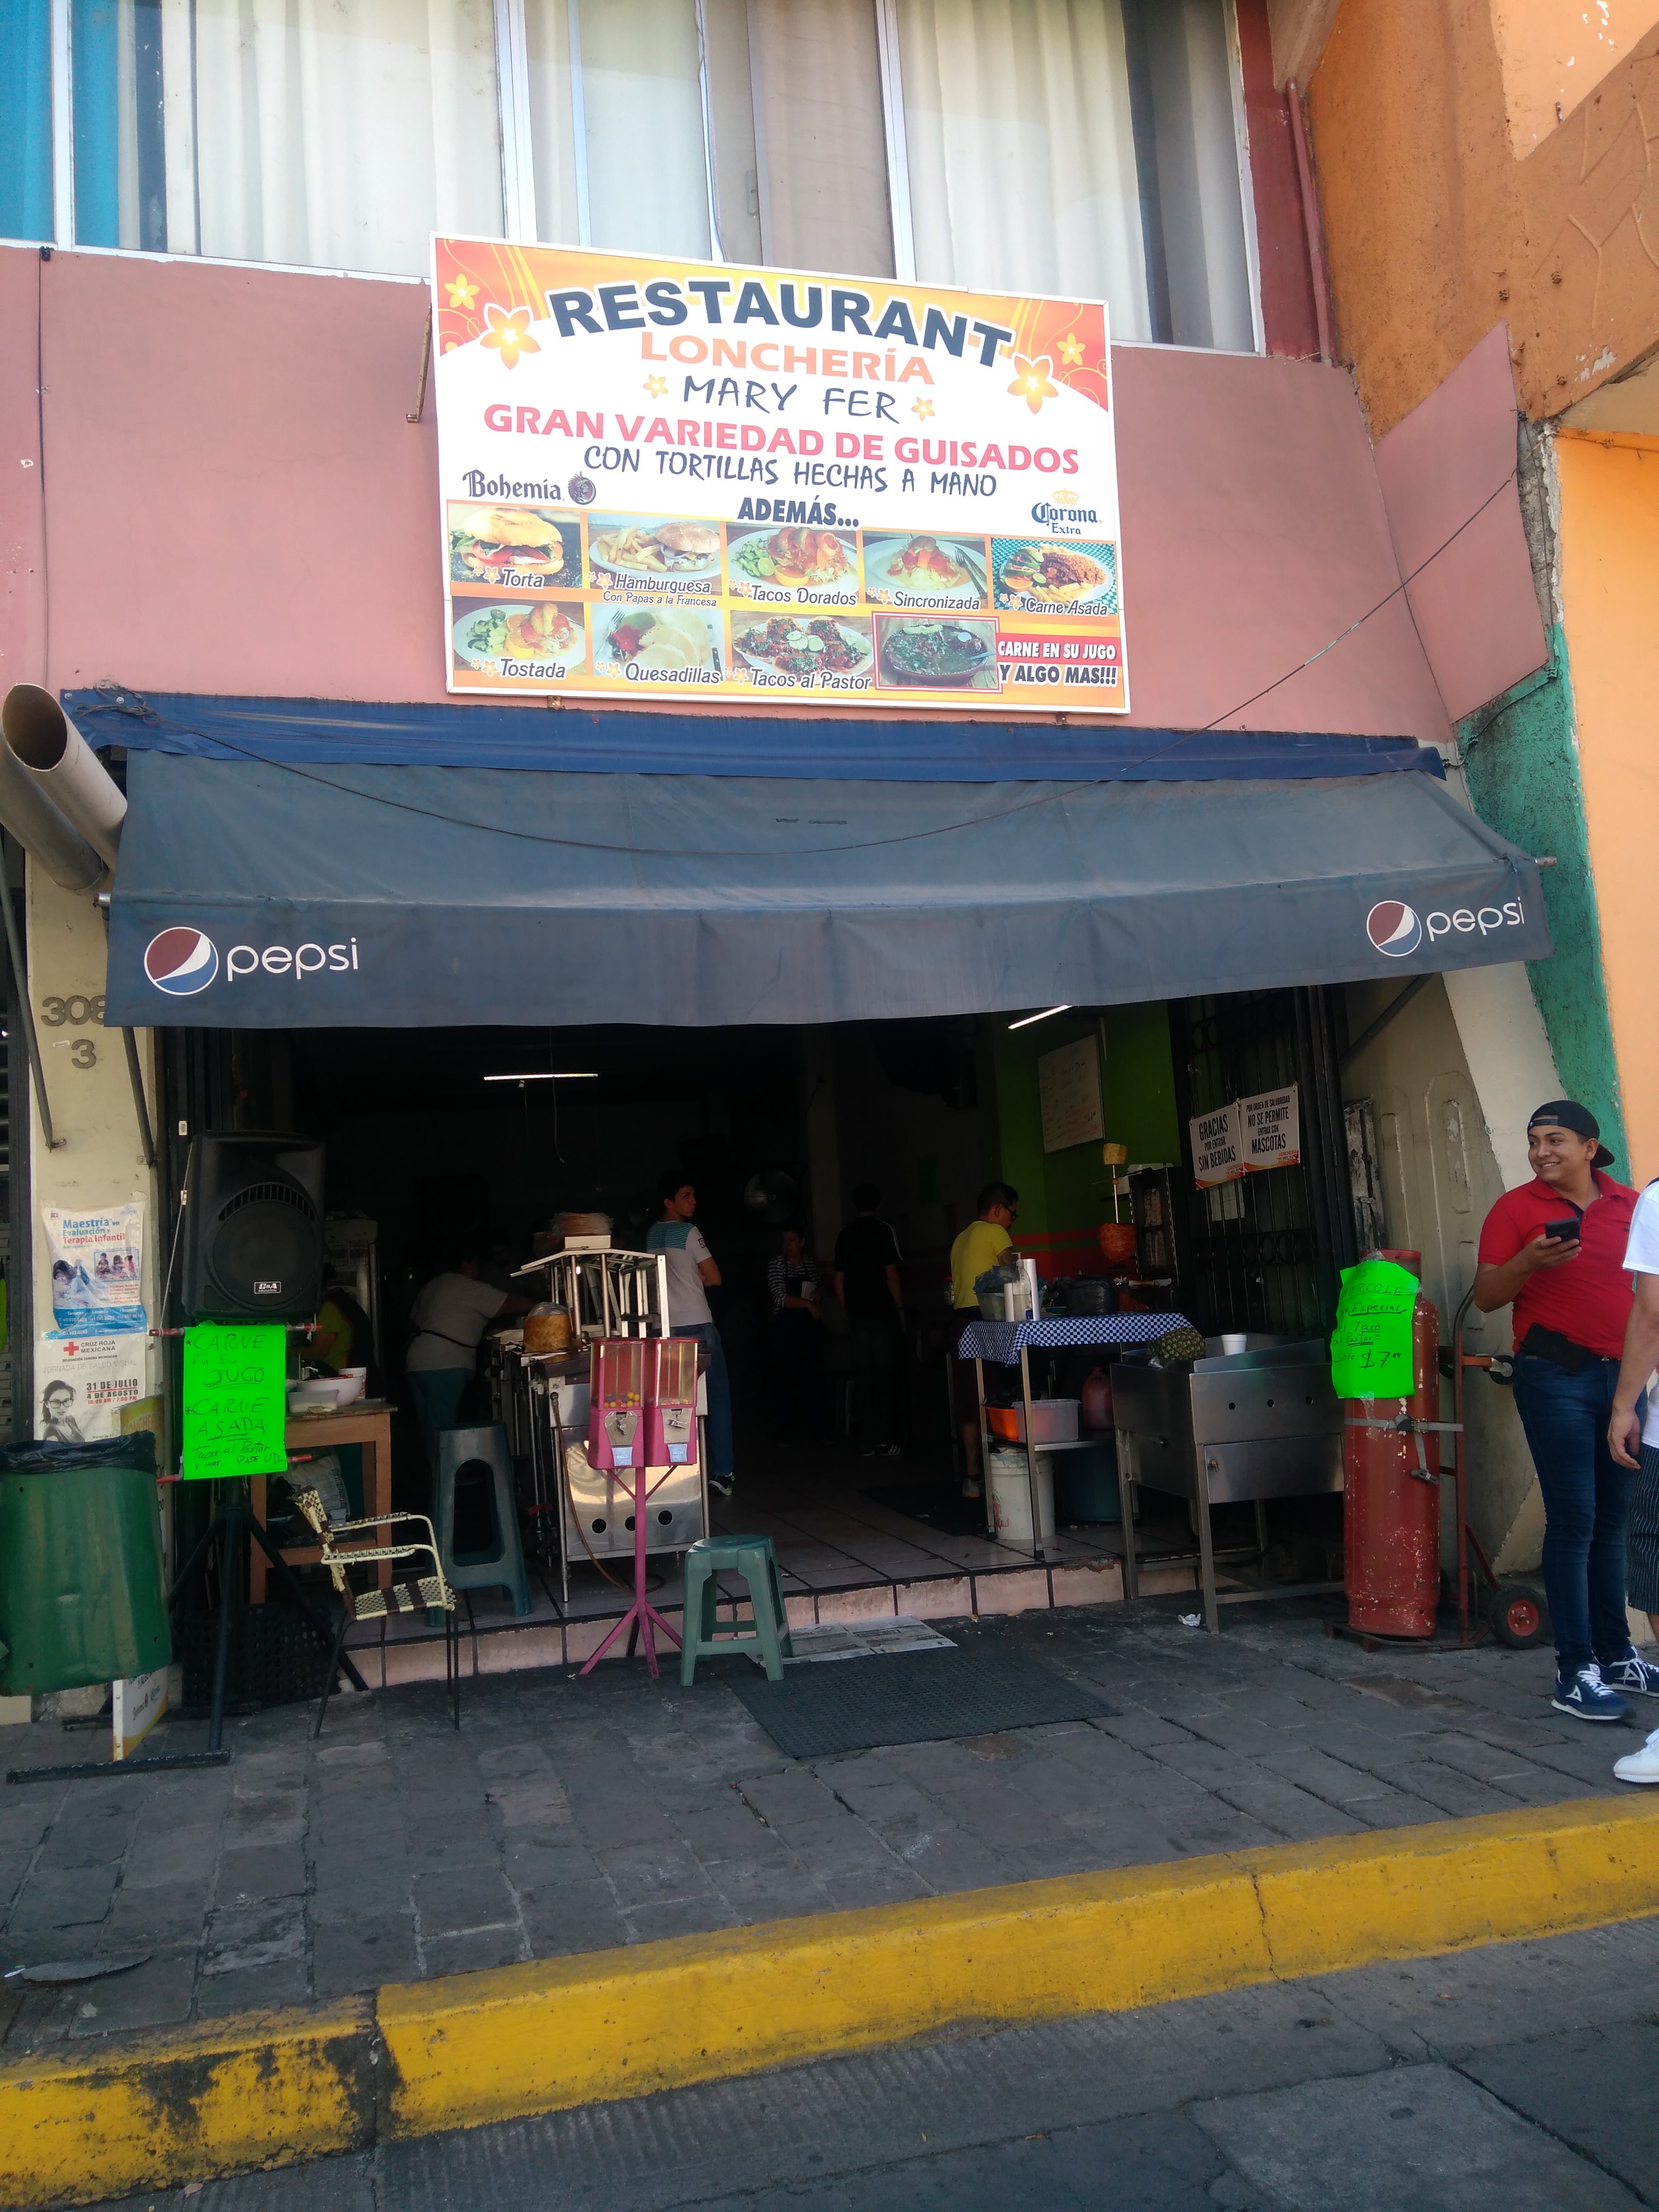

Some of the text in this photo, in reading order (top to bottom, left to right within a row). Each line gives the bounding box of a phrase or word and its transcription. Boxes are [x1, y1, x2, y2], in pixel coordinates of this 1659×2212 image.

[549, 281, 1012, 368] RESTAURANT
[641, 331, 935, 385] LONCHERÍA
[683, 375, 900, 424] MARY FER
[484, 404, 1079, 474] GRAN VARIEDAD DE GUISADOS
[584, 445, 997, 497] CON TORTILLAS HECHAS A MANO
[462, 469, 562, 501] Bohemia
[738, 495, 859, 527] ADEMÁS...
[1030, 501, 1098, 526] Corona
[1051, 523, 1082, 535] Extra
[502, 569, 543, 588] Torta
[615, 574, 711, 594] Hamburguesa
[603, 591, 624, 602] Con
[625, 592, 654, 605] Papas
[665, 594, 674, 605] la
[676, 594, 717, 607] Francesa
[751, 585, 857, 605] Tacos Dorados
[893, 591, 979, 610] Sincronizada
[1025, 597, 1108, 616] Carne Asada
[998, 640, 1116, 660] CARNE EN SU JUGO
[500, 658, 566, 678] Tostada
[625, 663, 720, 683] Quesadillas
[999, 664, 1117, 684] Y ALGO MAS!!!
[751, 669, 873, 690] Tacos al Pastor
[1426, 896, 1525, 942] pepsi
[227, 937, 358, 982] pepsi
[41, 994, 106, 1027] 308
[71, 1038, 96, 1069] 3
[1253, 1101, 1264, 1111] ORDEN
[1265, 1100, 1269, 1109] DE
[1269, 1095, 1290, 1108] SALUBRIDAD
[1247, 1106, 1289, 1127] NO SE PERMITE
[1199, 1113, 1228, 1141] GRACIAS
[1258, 1126, 1271, 1136] ENTRAR
[1212, 1136, 1226, 1150] ENTRAR
[1251, 1133, 1286, 1154] MASCOTAS
[1198, 1145, 1236, 1172] SIN BEBIDAS
[63, 1217, 110, 1229] Maestría
[63, 1226, 105, 1237] Evaluación
[63, 1233, 125, 1245] Terapia Infantil
[1351, 1302, 1402, 1314] Especial
[1353, 1321, 1380, 1333] Taco
[194, 1333, 266, 1351] CARNE
[1333, 1332, 1373, 1346] al Pastor
[87, 1382, 97, 1391] 31
[114, 1378, 138, 1388] JULIO
[204, 1366, 265, 1387] JUGO
[107, 1389, 138, 1397] AGOSTO
[192, 1397, 269, 1415] CARNE
[193, 1417, 265, 1438] ASADA
[223, 1445, 236, 1455] al
[240, 1440, 270, 1454] Pastor
[237, 1455, 259, 1465] PASE
